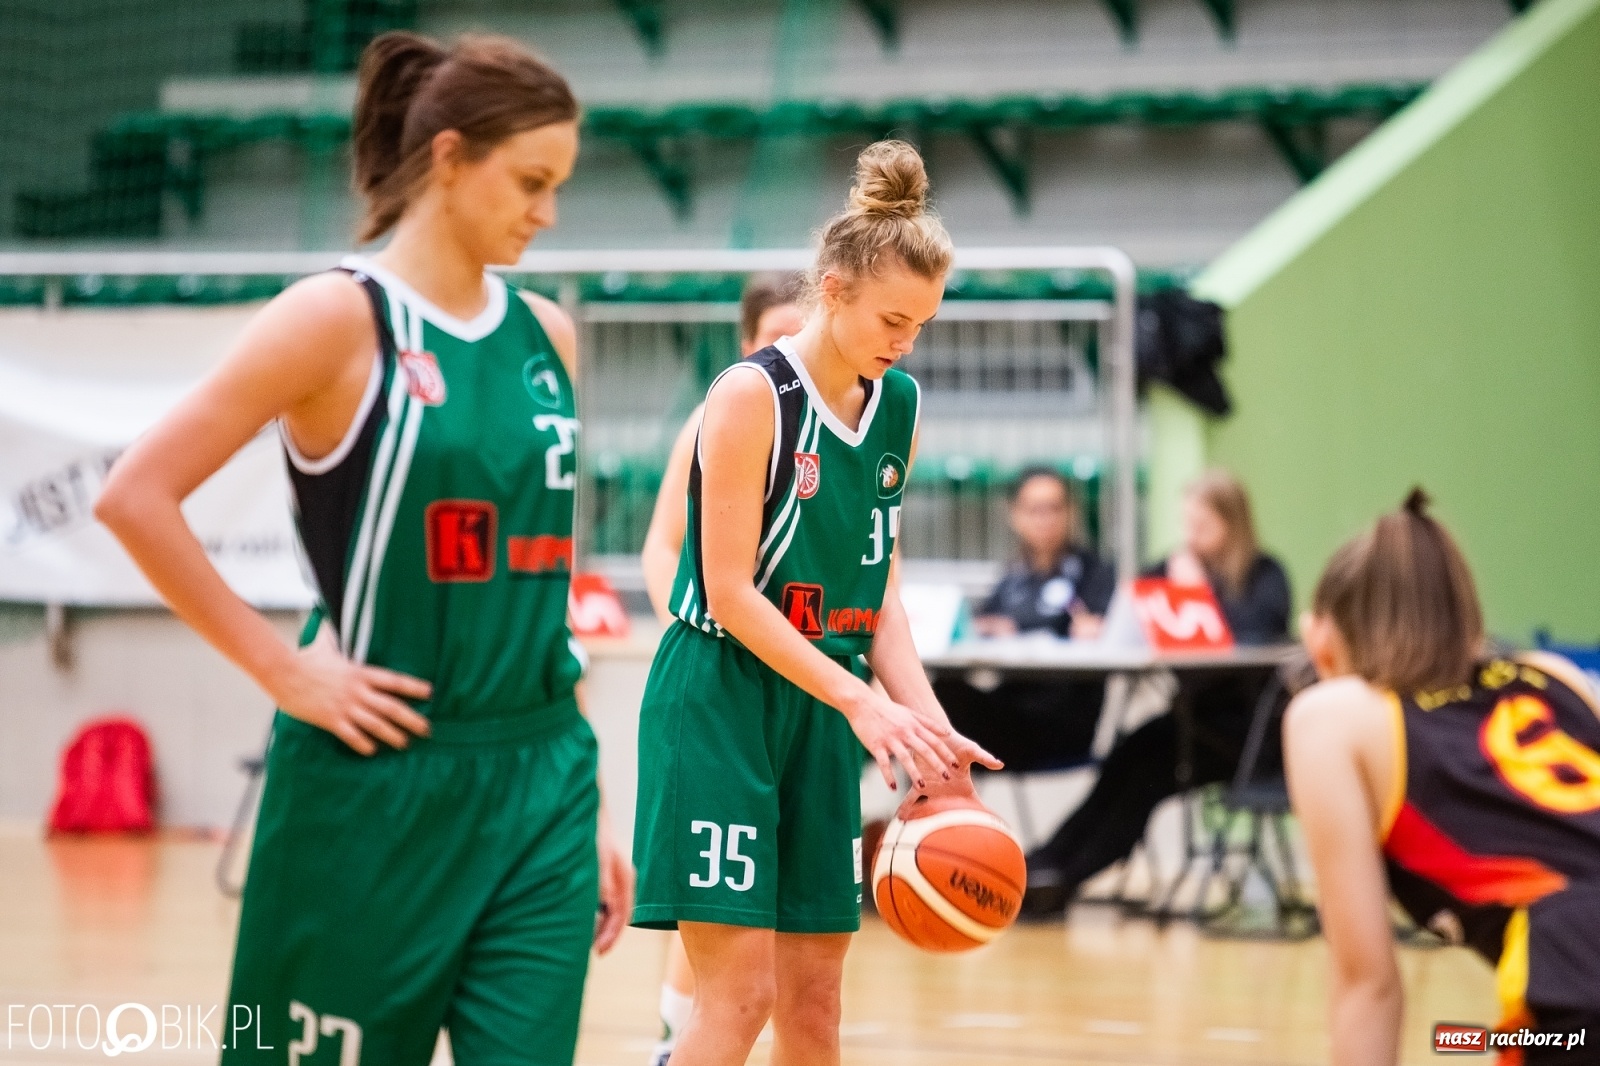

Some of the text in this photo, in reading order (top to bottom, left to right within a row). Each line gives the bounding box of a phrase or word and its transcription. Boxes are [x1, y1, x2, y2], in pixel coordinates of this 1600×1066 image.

[533, 414, 580, 490] 2
[788, 589, 822, 632] K
[1478, 694, 1600, 815] 6
[689, 819, 757, 892] 35
